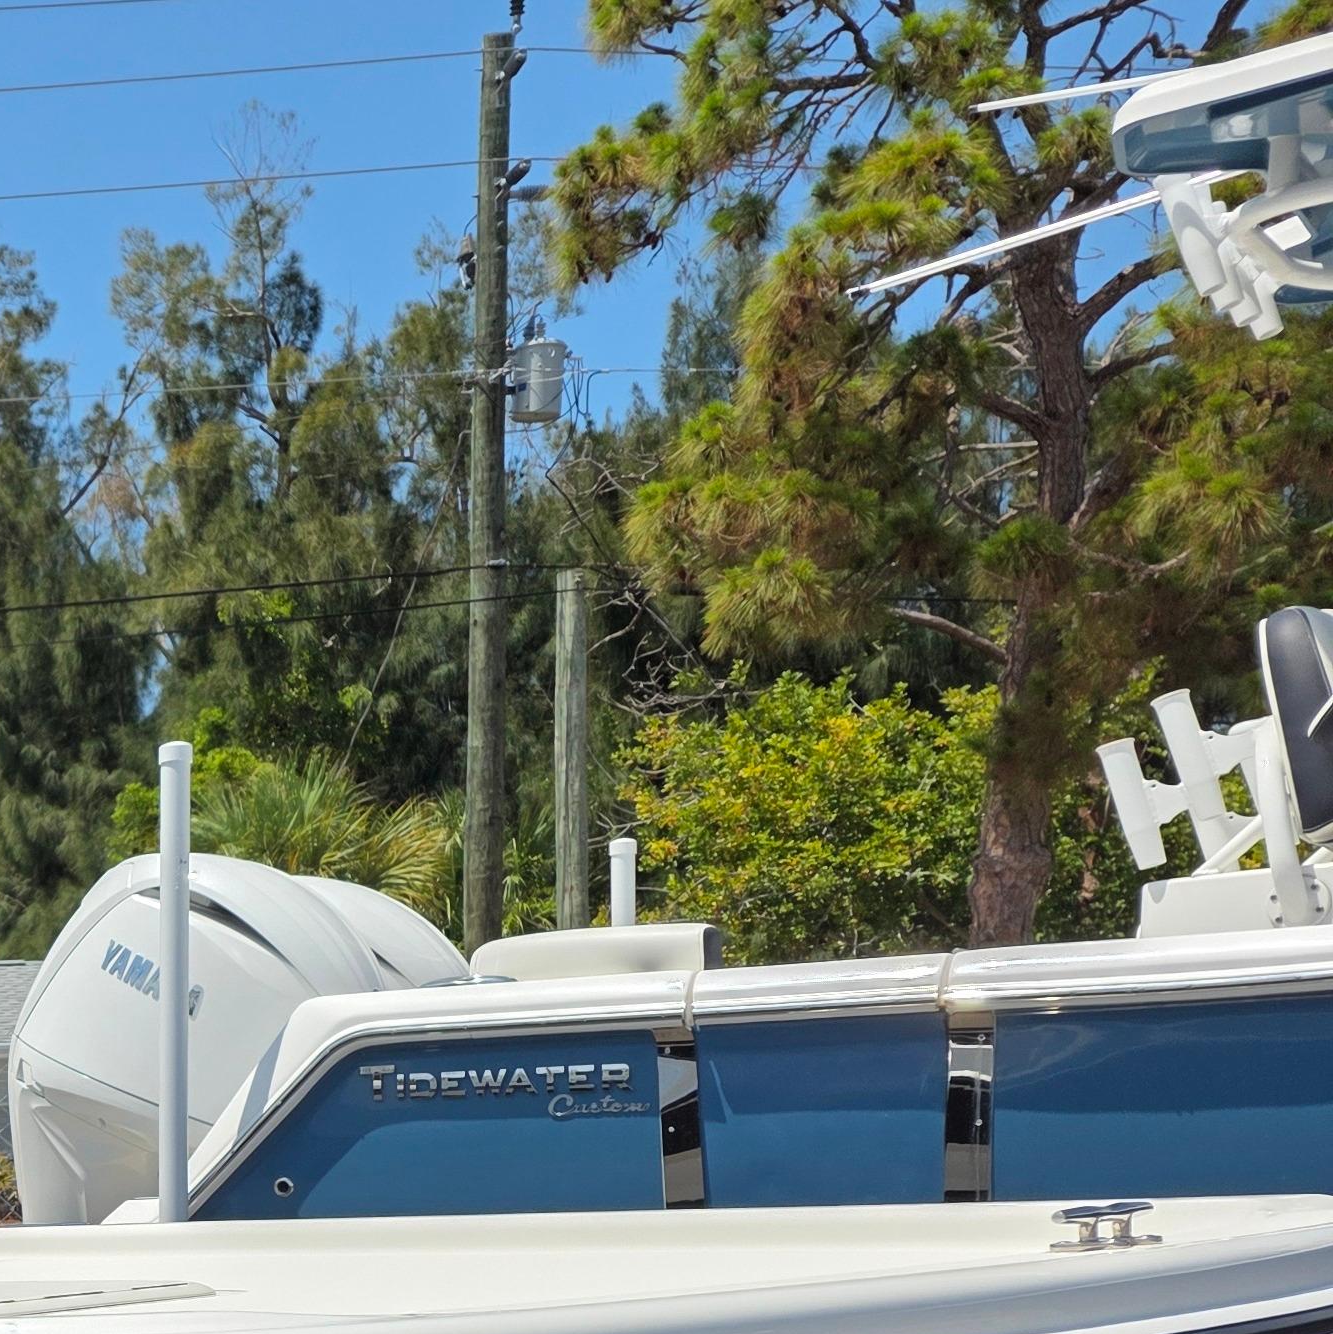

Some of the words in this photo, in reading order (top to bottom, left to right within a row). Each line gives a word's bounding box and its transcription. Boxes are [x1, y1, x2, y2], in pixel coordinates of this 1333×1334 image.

[101, 939, 160, 1002] YAMA
[359, 1063, 632, 1100] TIDEWATER
[547, 1094, 650, 1119] Custom
